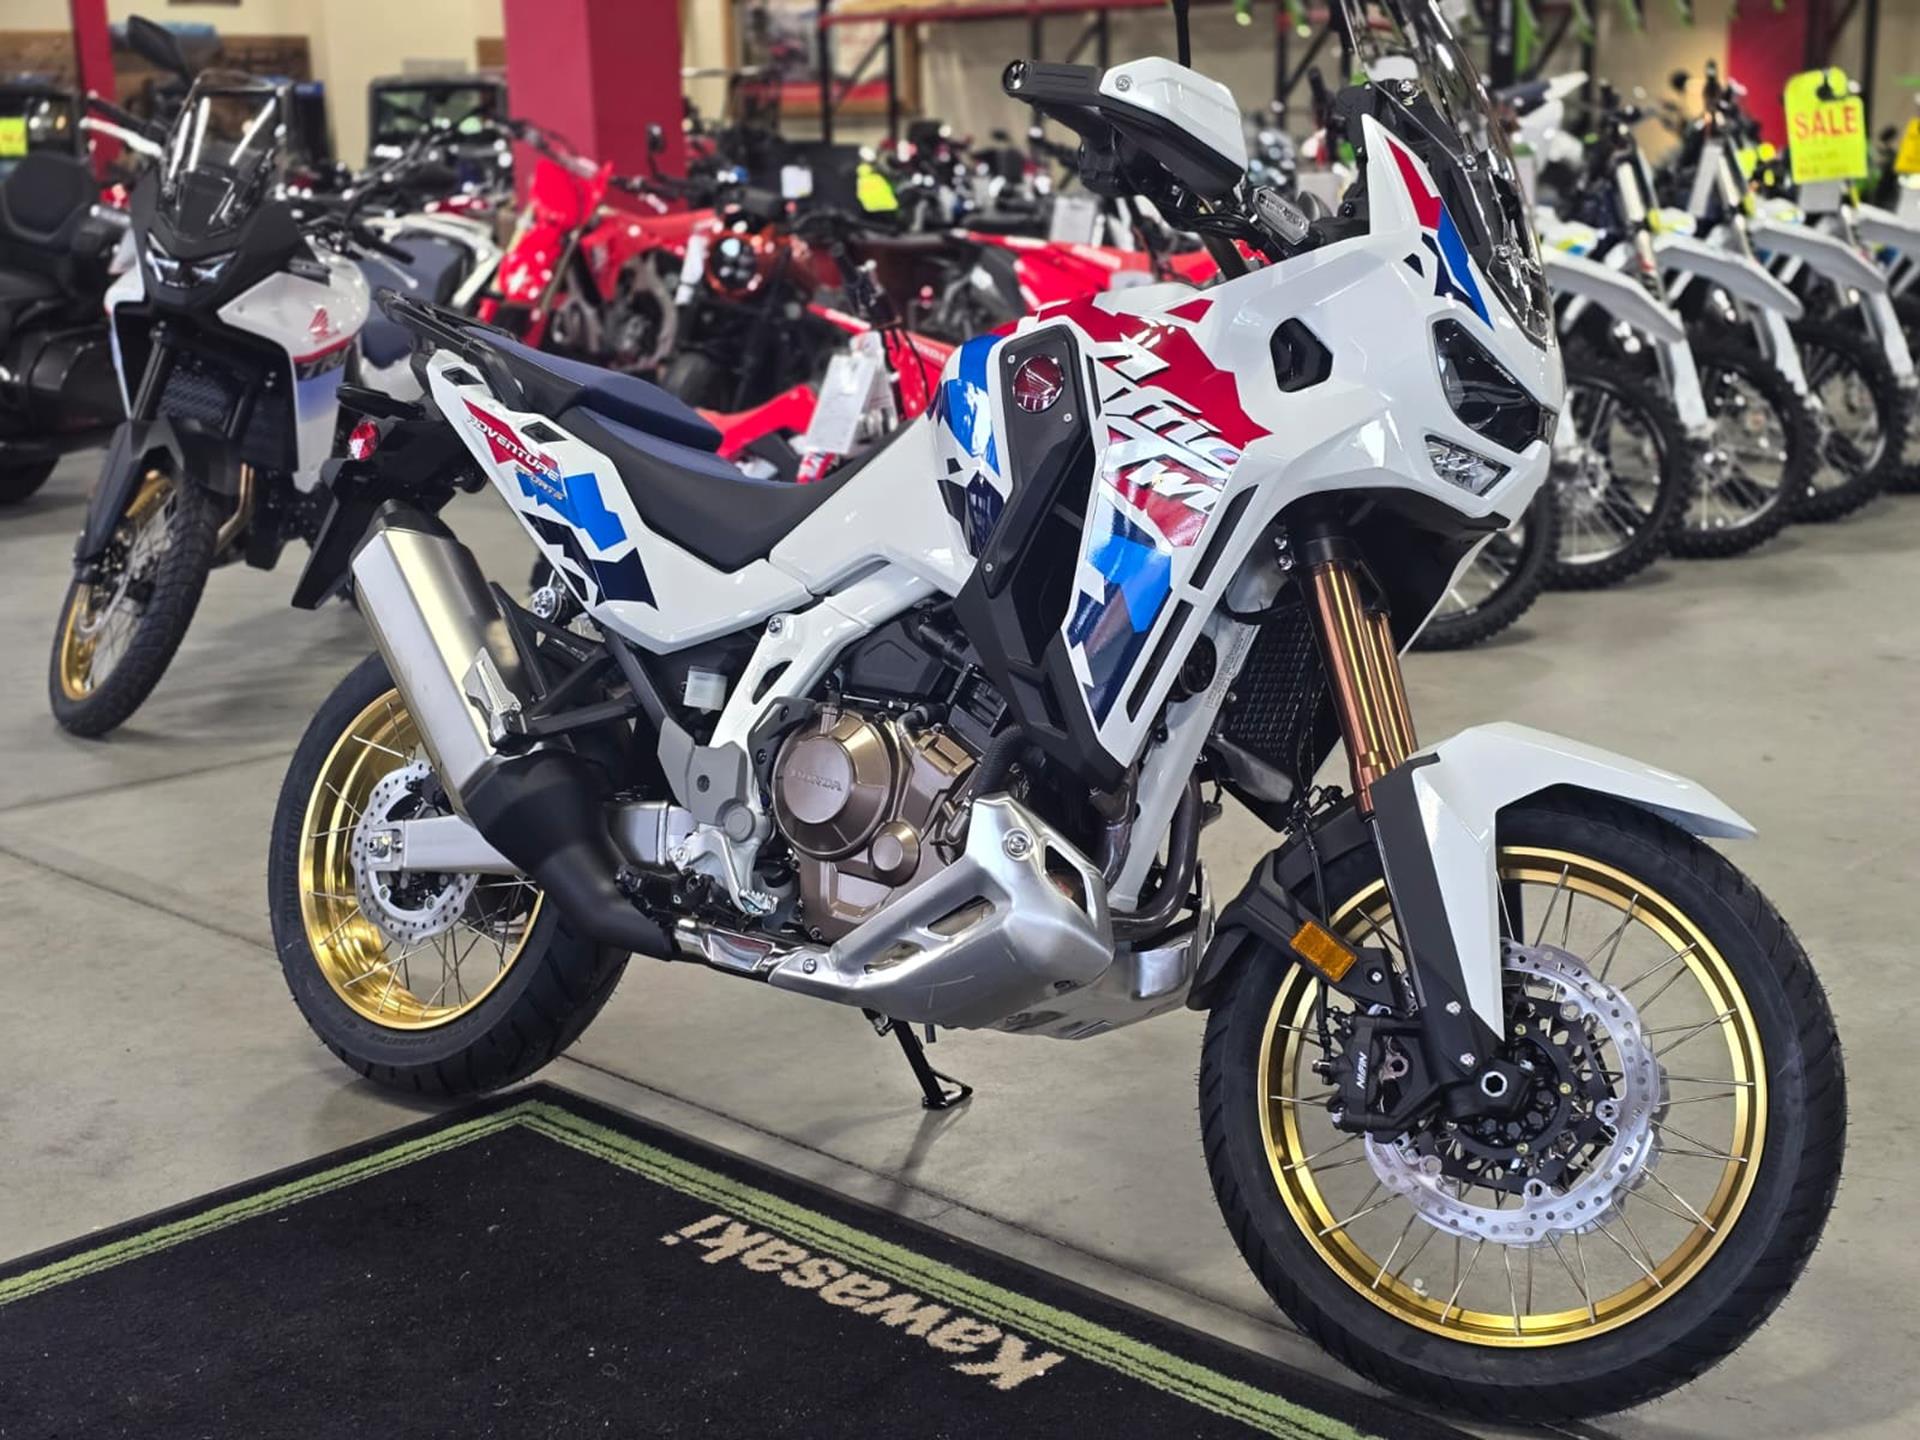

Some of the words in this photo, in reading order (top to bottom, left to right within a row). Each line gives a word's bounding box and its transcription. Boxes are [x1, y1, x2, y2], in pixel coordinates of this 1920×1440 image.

[1794, 106, 1856, 140] SALE
[467, 414, 561, 482] ADVENTURE
[659, 1213, 1067, 1391] Kawasaki
